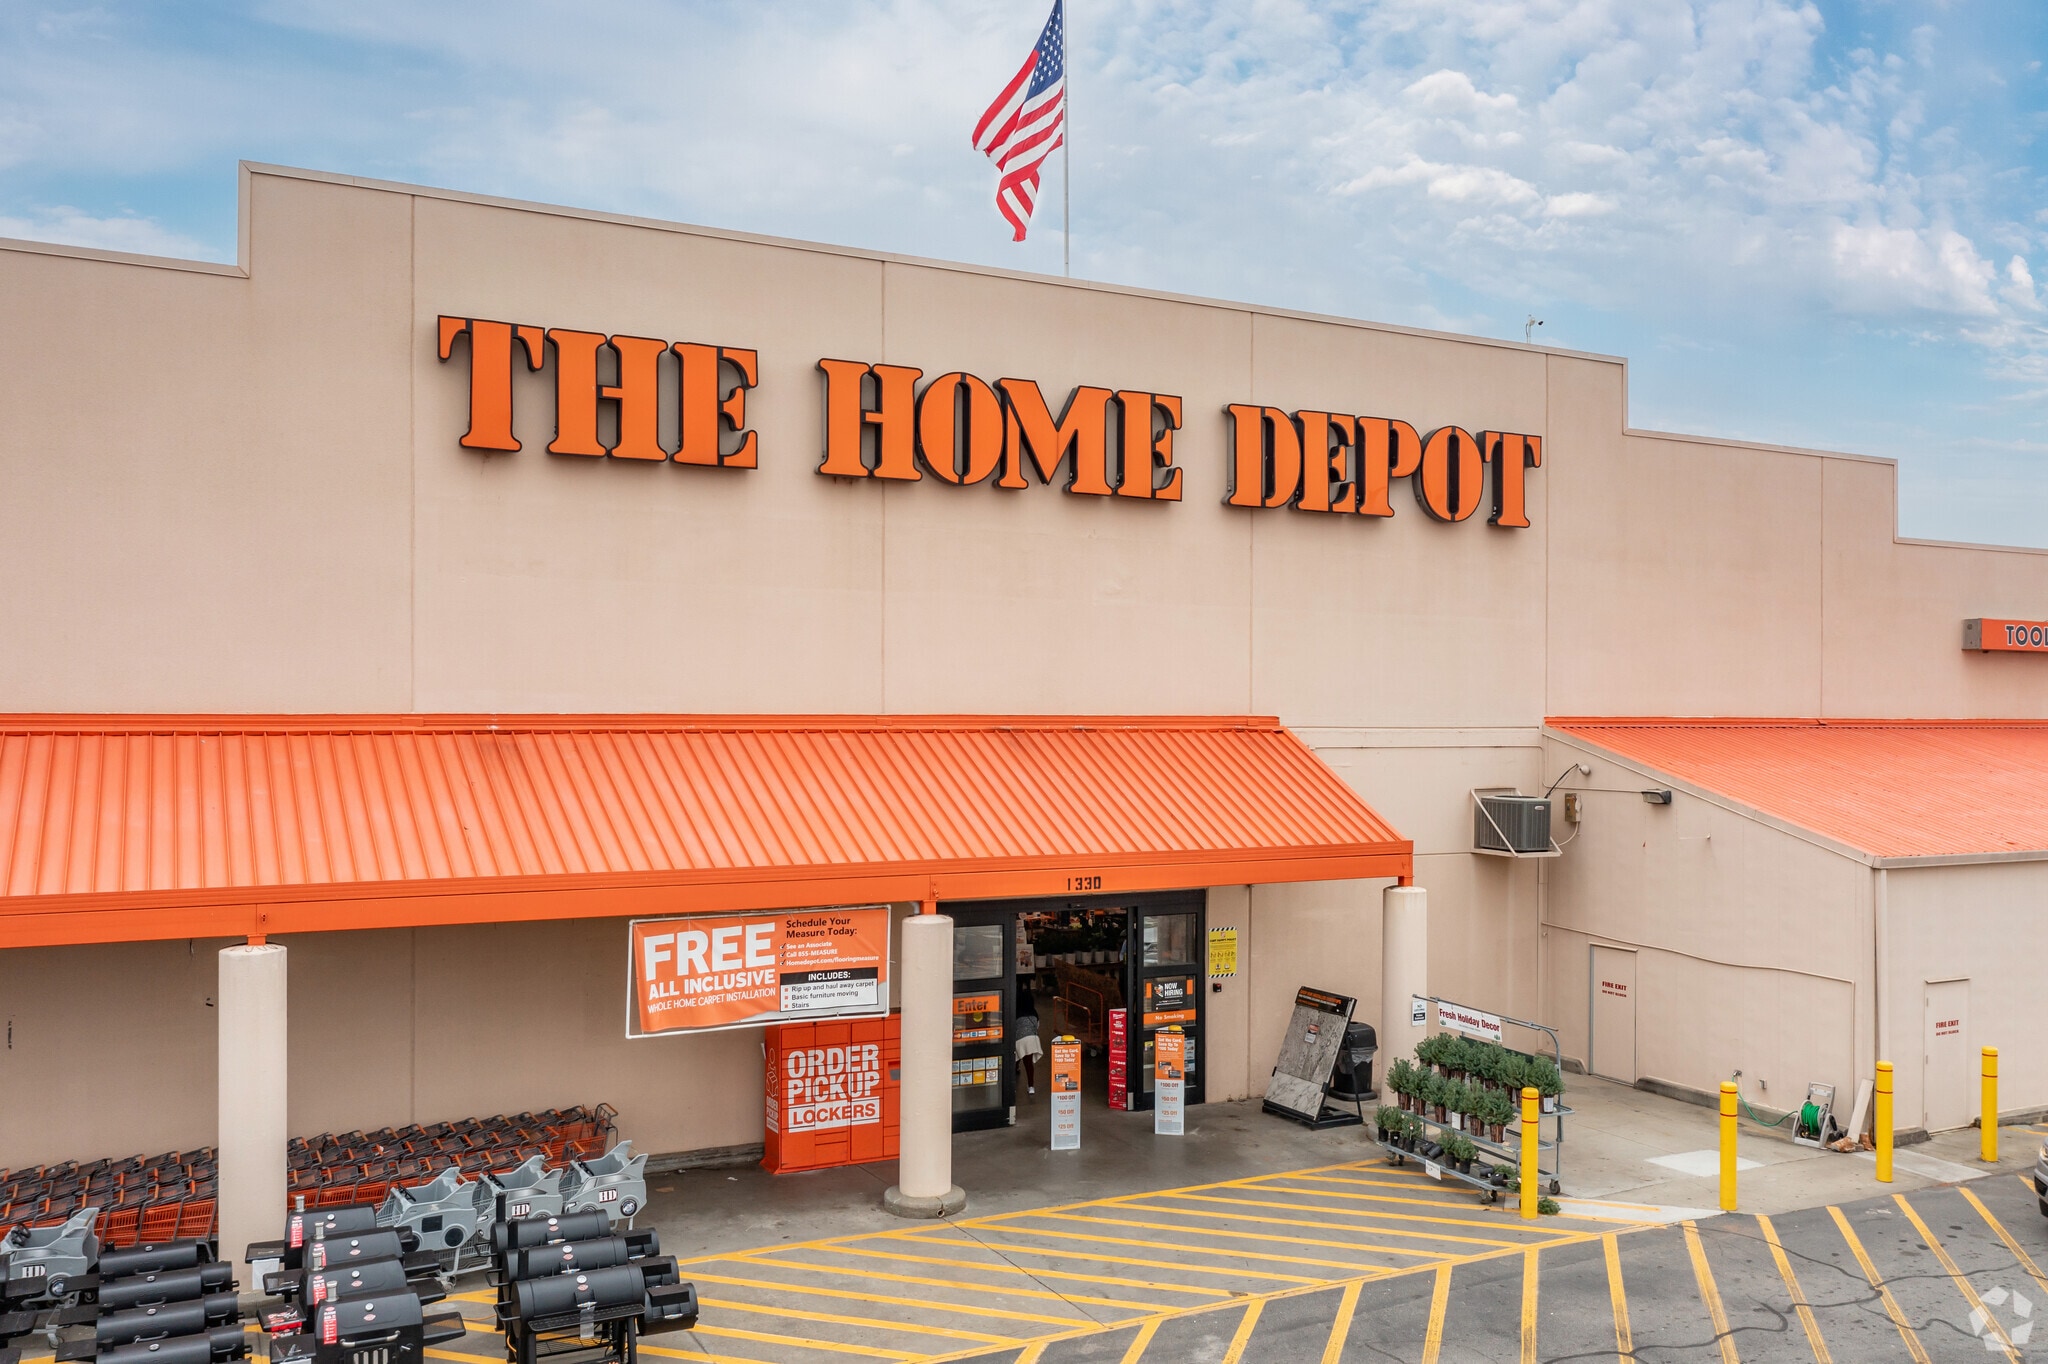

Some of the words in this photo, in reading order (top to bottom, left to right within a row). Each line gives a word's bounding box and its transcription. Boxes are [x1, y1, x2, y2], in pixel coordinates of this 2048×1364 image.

[437, 314, 758, 470] THE
[815, 357, 1183, 501] HOME
[1221, 403, 1543, 528] DEPOT
[2005, 624, 2048, 647] TOO
[1067, 876, 1101, 891] 1330
[786, 918, 827, 929] Schedule
[829, 917, 851, 926] Your
[786, 929, 825, 938] Measure
[828, 927, 858, 937] Today:
[644, 922, 775, 982] FREE
[797, 949, 838, 957] 855-MEASURE
[808, 971, 851, 981] INCLUDES:
[649, 980, 680, 1000] ALL
[684, 968, 776, 994] INCLUSIVE
[1164, 982, 1178, 990] NOW
[1615, 983, 1627, 991] EXIT
[809, 991, 836, 999] furniture
[1164, 988, 1183, 996] HIRING
[647, 1000, 672, 1014] WHOLE
[673, 998, 696, 1008] HOME
[698, 993, 725, 1006] CARPET
[726, 987, 776, 1001] INSTALLATION
[957, 999, 989, 1012] Enter
[1439, 1008, 1456, 1020] Fresh
[1457, 1012, 1480, 1028] Holiday
[1481, 1019, 1500, 1031] Decor
[788, 1044, 879, 1078] ORDER
[788, 1071, 880, 1105] PICKUP
[793, 1102, 876, 1125] LOCKERS
[599, 1189, 617, 1203] HD
[511, 1203, 531, 1217] HD
[21, 1265, 46, 1278] HD
